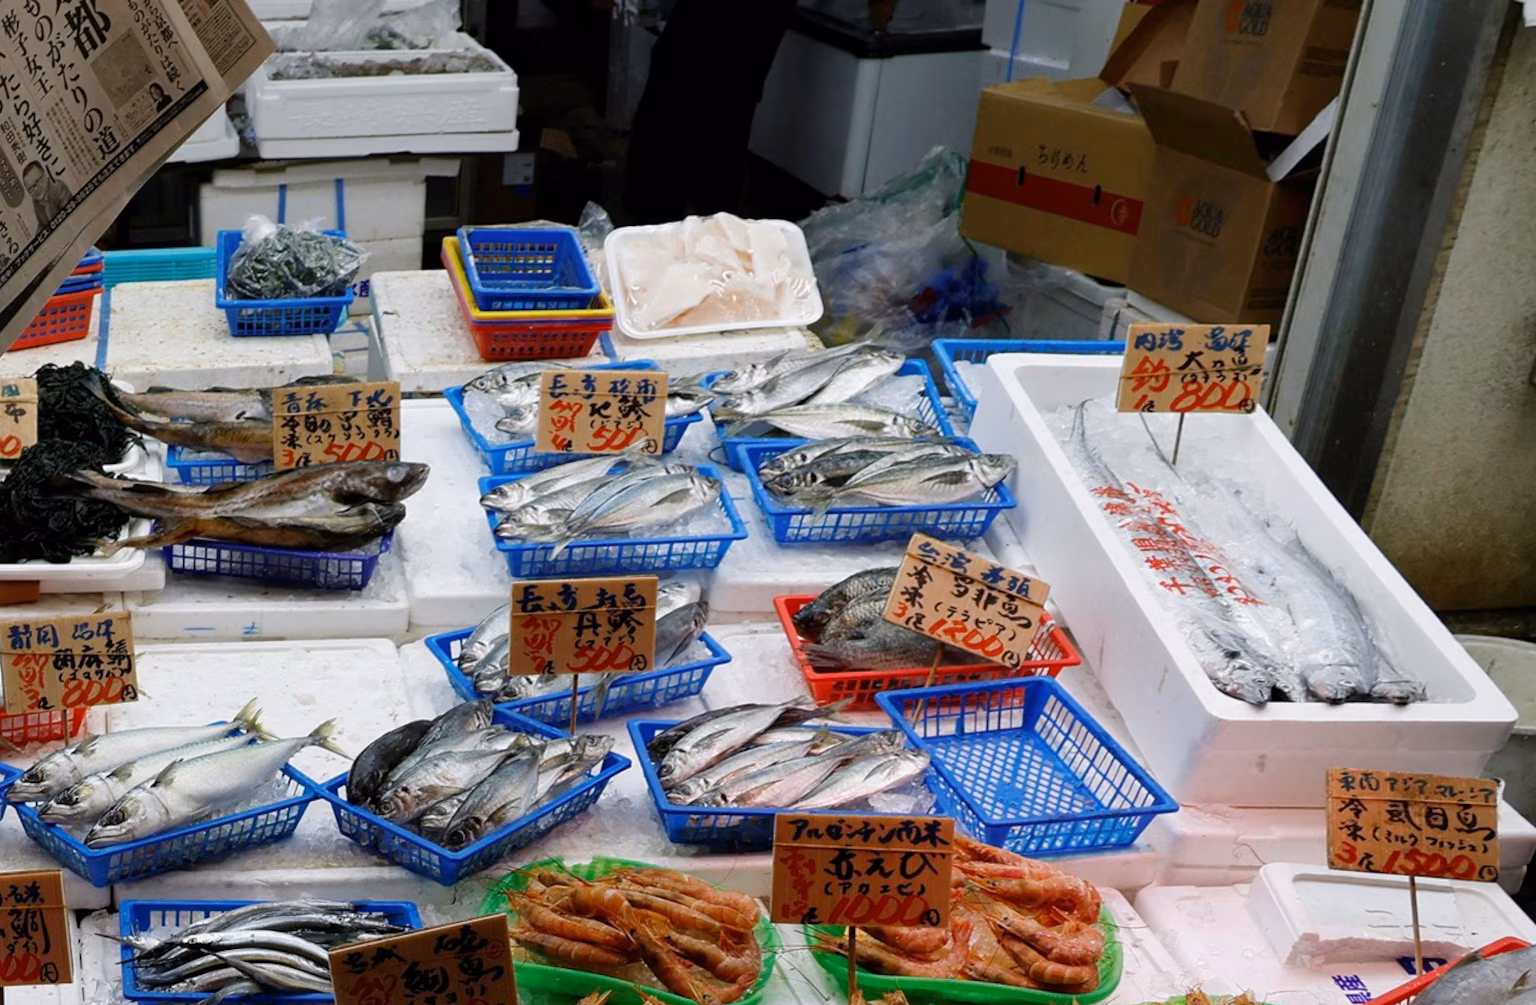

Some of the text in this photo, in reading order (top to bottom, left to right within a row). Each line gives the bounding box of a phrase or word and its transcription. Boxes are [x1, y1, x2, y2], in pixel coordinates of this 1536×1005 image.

[1, 9, 54, 101] 彬子女王
[1038, 145, 1089, 174] ちりめん
[281, 392, 328, 413] 青森
[517, 583, 579, 612] 長崎
[934, 601, 1017, 642] (テラピア)
[7, 624, 59, 650] 静岡
[1337, 772, 1495, 803] 東南アジア マレーシア
[824, 845, 947, 880] 赤えび
[824, 881, 926, 896] (アカエビ)
